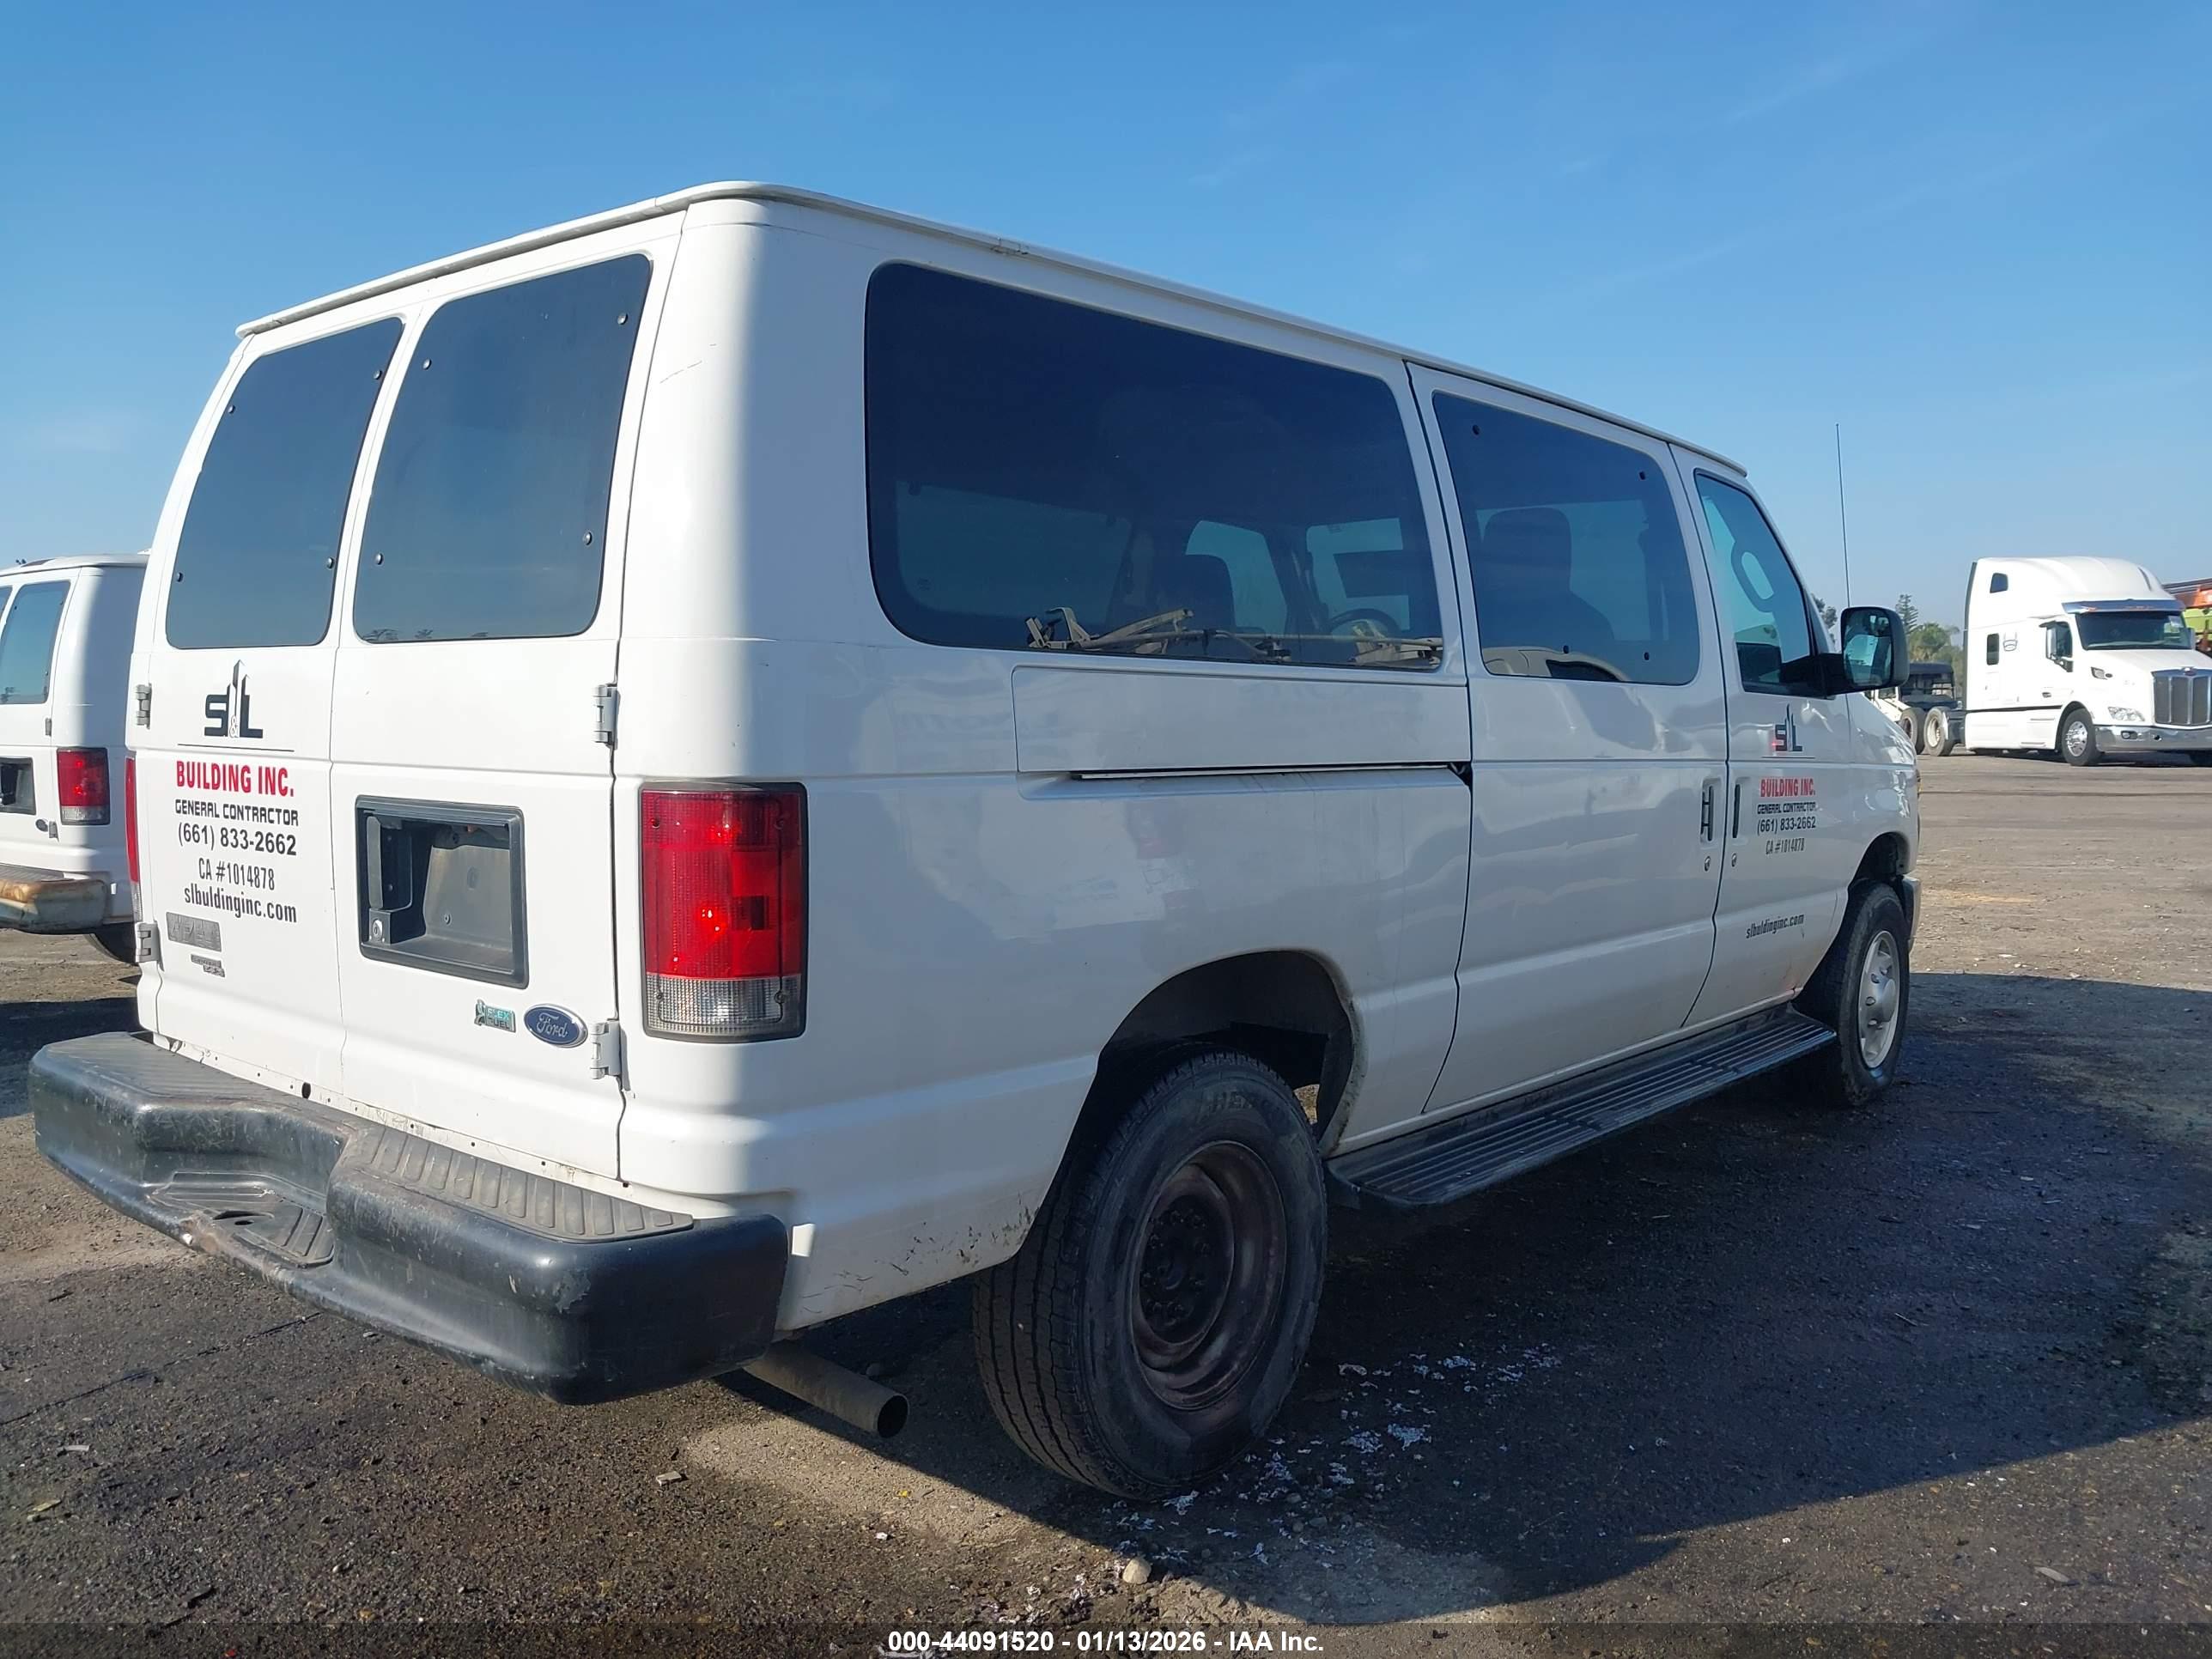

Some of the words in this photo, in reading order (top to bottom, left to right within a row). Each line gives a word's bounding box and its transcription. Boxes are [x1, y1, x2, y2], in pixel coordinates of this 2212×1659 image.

[176, 760, 252, 793] BUILDING
[258, 766, 295, 798] INC.
[1760, 778, 1799, 798] BUILDING
[1800, 777, 1816, 796] INC.
[175, 799, 220, 818] GENERAL
[222, 805, 299, 827] CONTRACTOR
[1757, 804, 1782, 815] GENERAL
[1757, 818, 1778, 836] (661)
[1780, 816, 1816, 831] 833-2662
[178, 823, 215, 850] (661)
[220, 826, 297, 856] 833-2662
[198, 857, 213, 881] CA
[216, 860, 275, 891] #1014878
[184, 884, 297, 923] slbuldinginc.com
[487, 1008, 510, 1021] FLEX
[487, 1017, 510, 1030] FUEL
[536, 1012, 568, 1038] Ford
